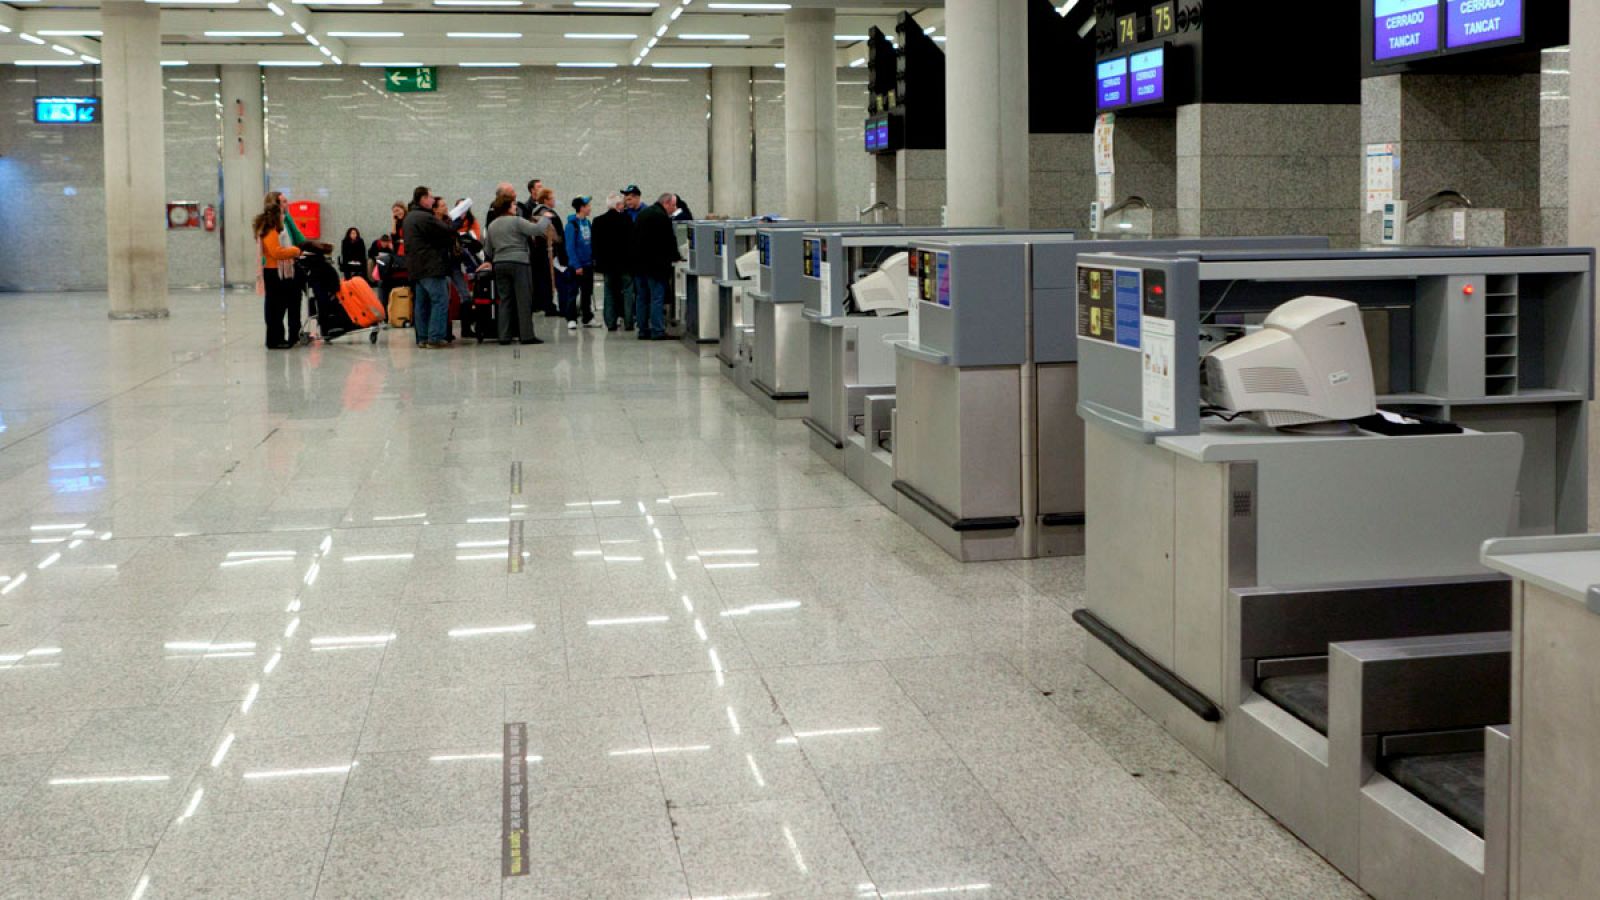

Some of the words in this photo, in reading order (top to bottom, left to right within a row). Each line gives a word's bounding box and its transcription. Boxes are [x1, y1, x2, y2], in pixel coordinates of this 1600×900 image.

[1155, 6, 1171, 33] 75
[1386, 11, 1424, 29] CERRADO
[1464, 17, 1501, 36] TANCAT
[1119, 17, 1134, 43] 74
[1389, 33, 1420, 49] TANCAT
